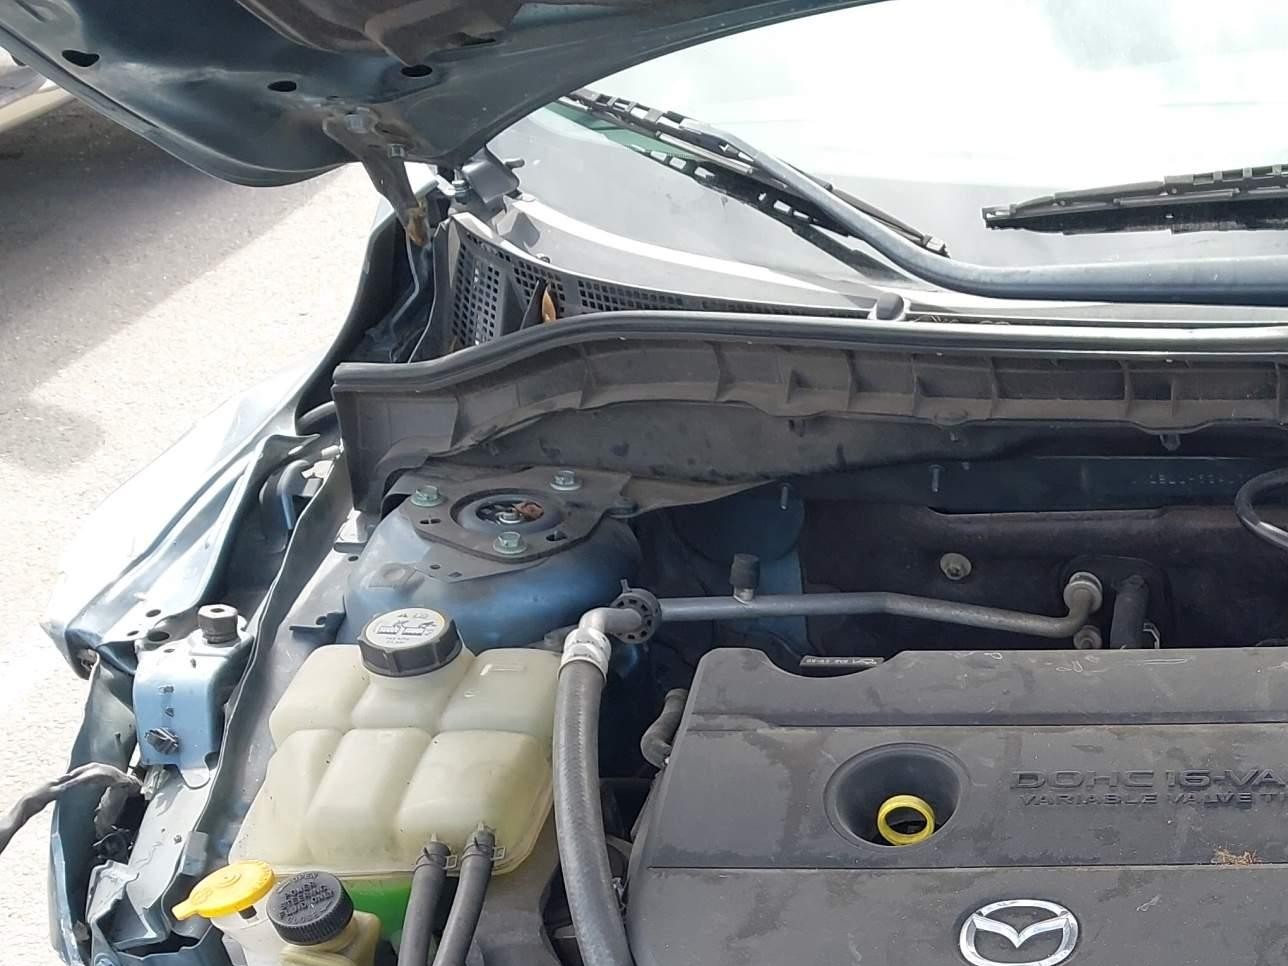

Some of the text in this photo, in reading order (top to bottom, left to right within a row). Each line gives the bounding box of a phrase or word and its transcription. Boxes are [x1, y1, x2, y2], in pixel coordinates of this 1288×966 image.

[1010, 769, 1155, 791] DOHC
[1019, 791, 1158, 807] VARIABLE
[1170, 790, 1253, 808] VALVE
[285, 881, 317, 900] POWER
